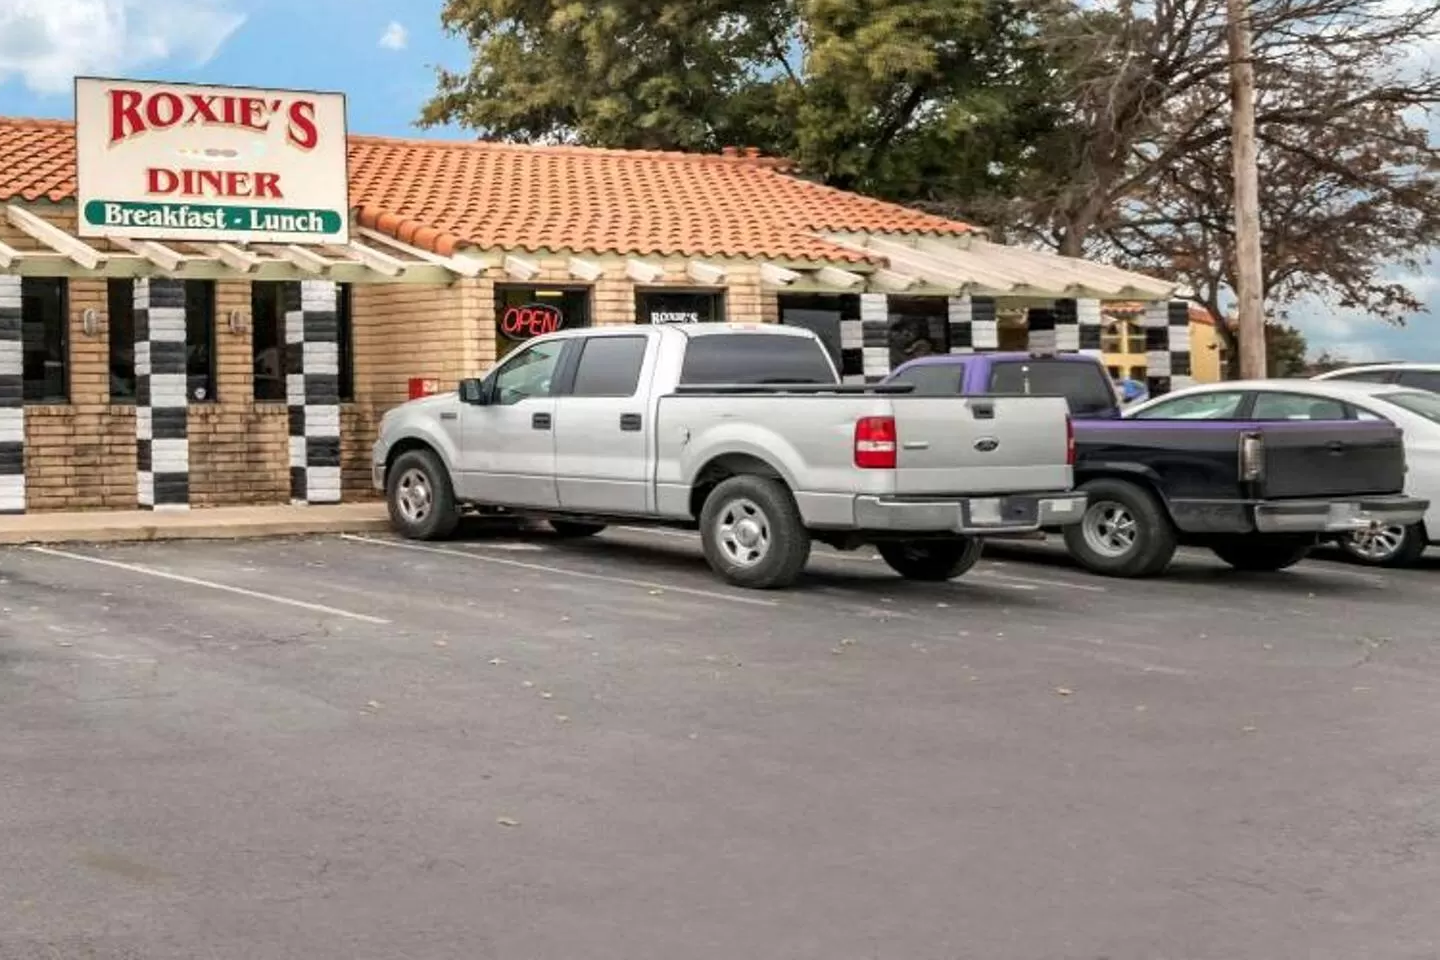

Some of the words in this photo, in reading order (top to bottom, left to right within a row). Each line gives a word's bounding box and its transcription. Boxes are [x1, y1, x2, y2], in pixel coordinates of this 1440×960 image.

[109, 89, 318, 149] ROXIE'S
[147, 167, 284, 198] DINER
[105, 203, 227, 229] Breakfast
[250, 209, 323, 232] Lunch
[503, 308, 558, 336] OPEN
